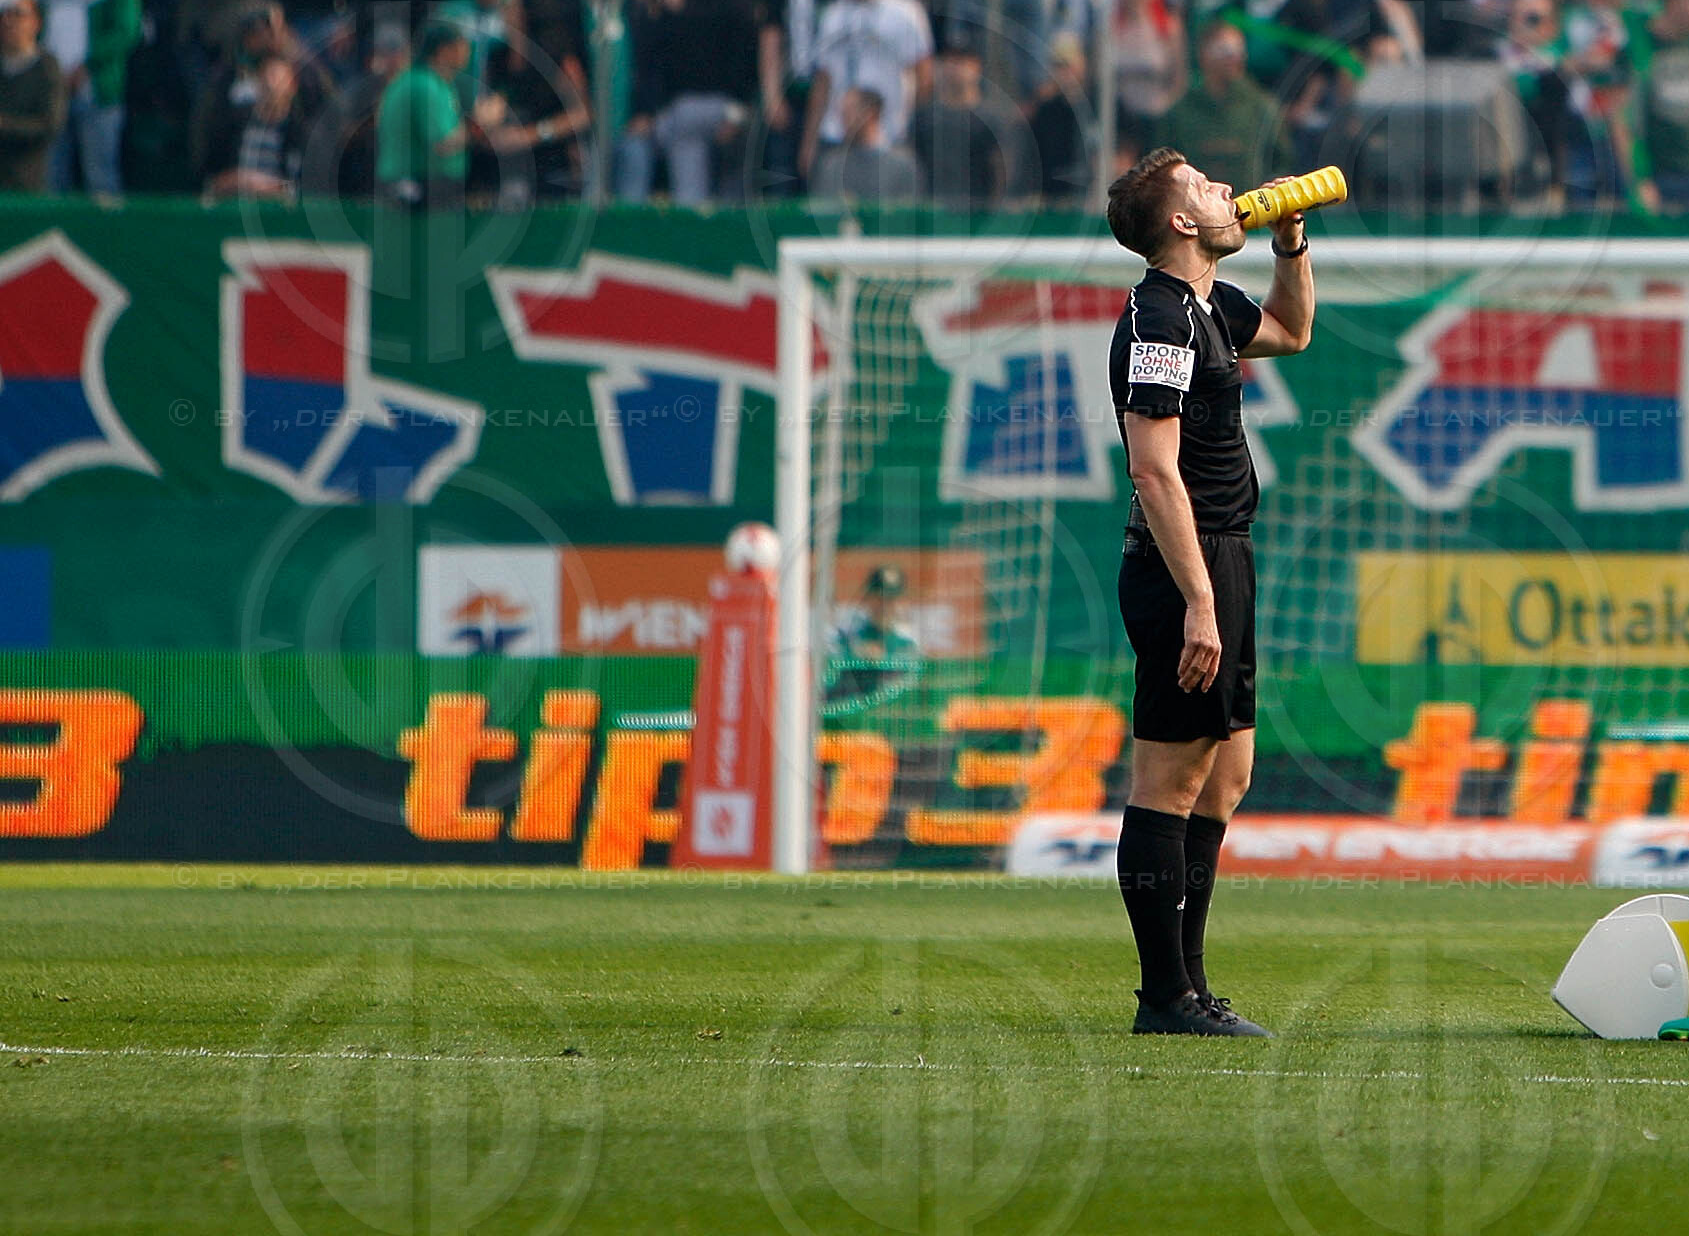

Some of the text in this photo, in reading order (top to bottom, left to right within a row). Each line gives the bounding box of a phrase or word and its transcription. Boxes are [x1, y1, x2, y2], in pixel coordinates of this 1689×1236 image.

[1135, 345, 1191, 362] SPORT
[1142, 356, 1182, 371] OHNE
[1133, 365, 1188, 382] DOPING
